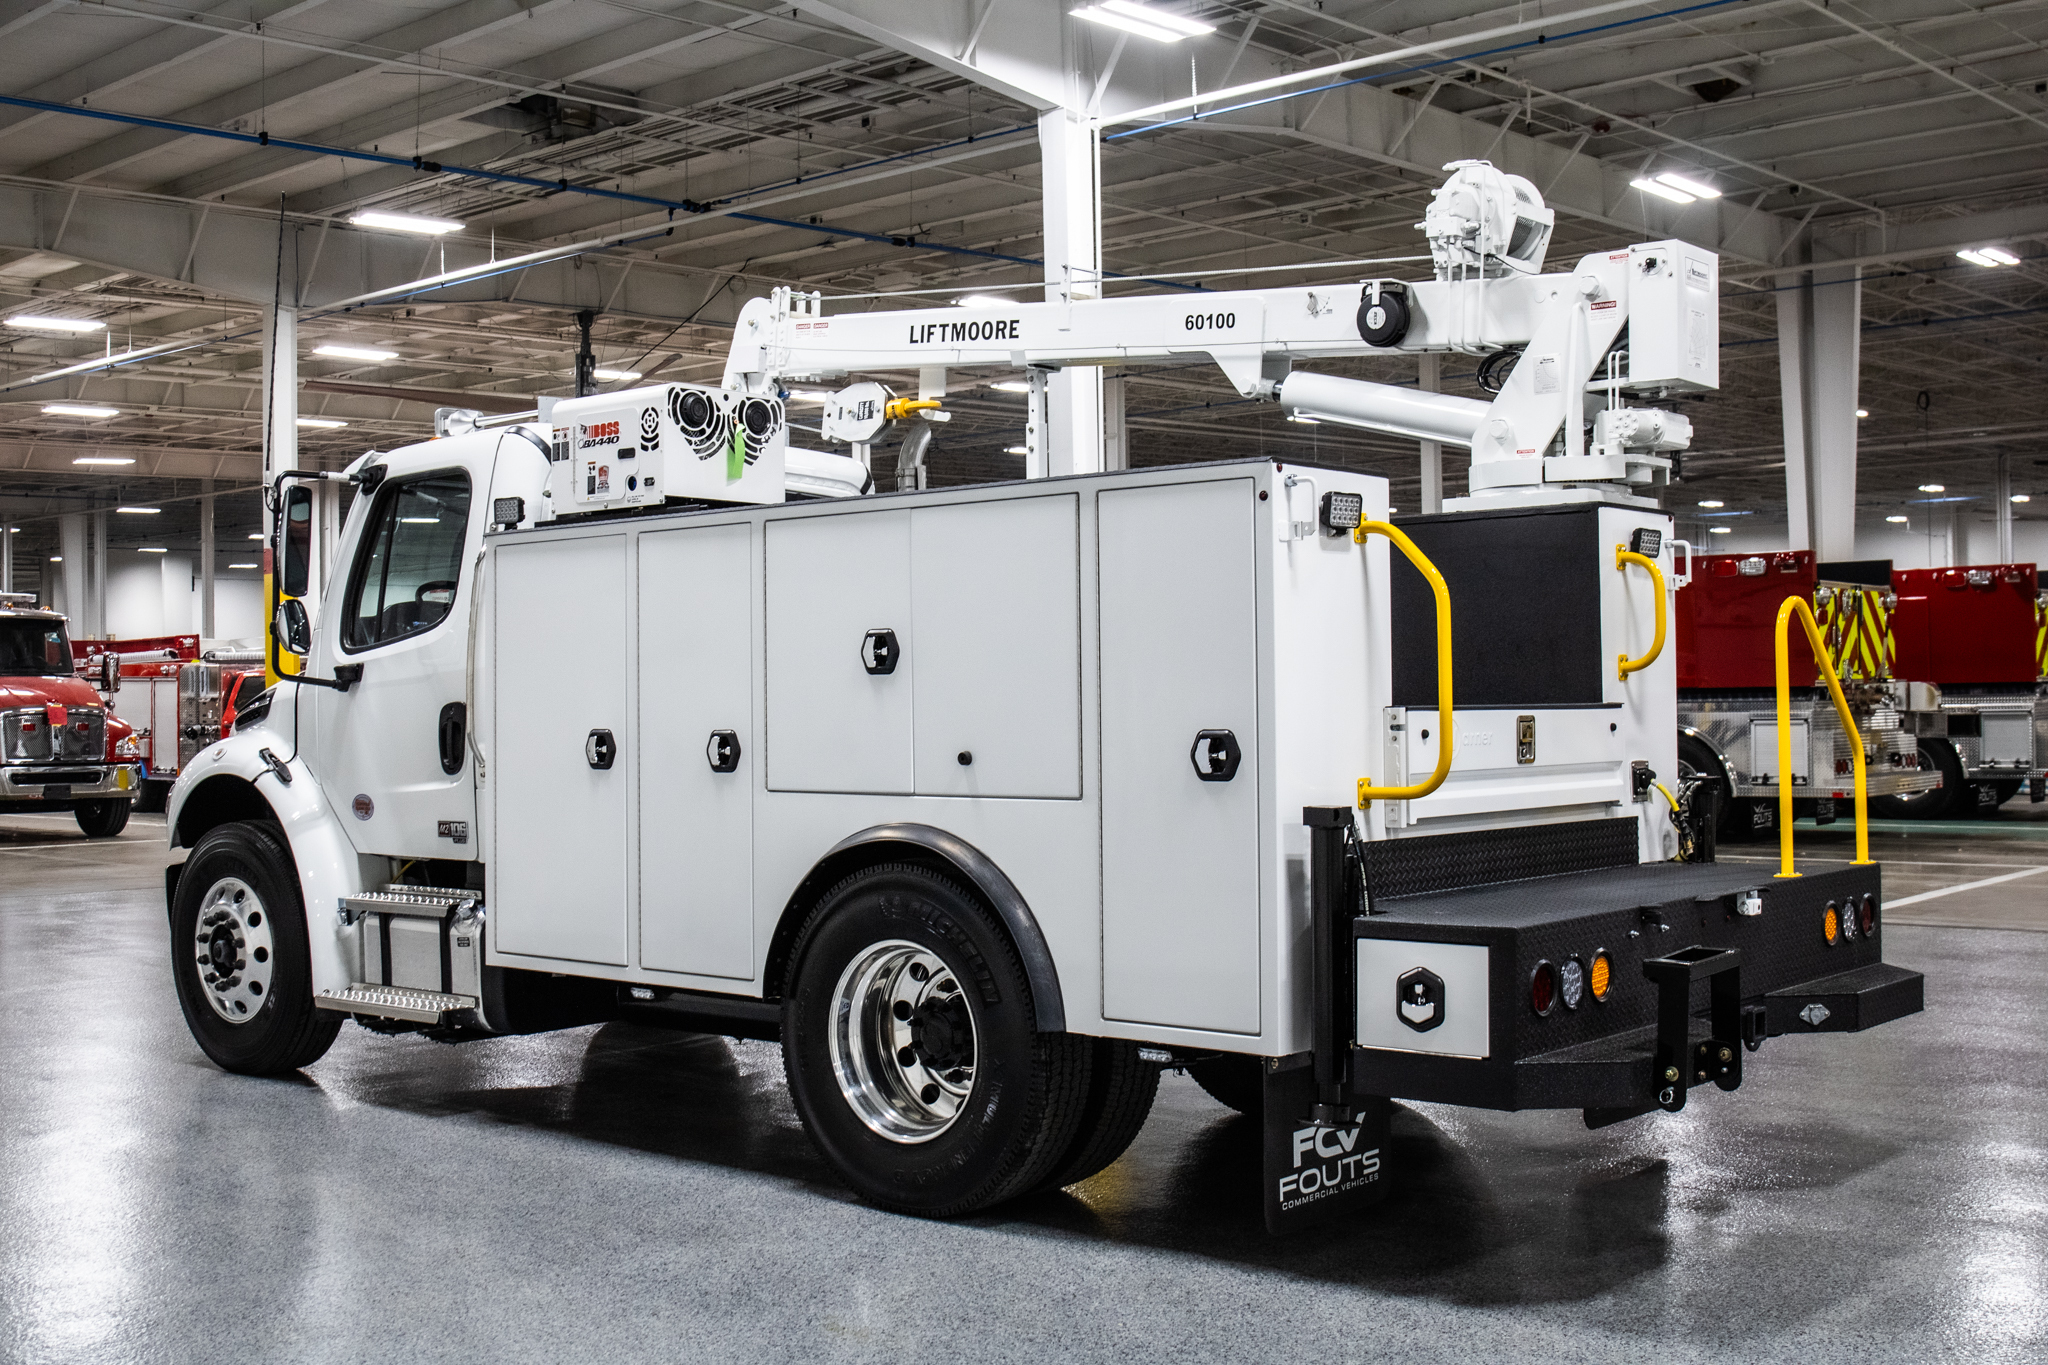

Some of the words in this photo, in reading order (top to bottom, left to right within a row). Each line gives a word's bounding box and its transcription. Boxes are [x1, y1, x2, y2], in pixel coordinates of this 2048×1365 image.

[1591, 301, 1616, 310] WARNING!
[909, 319, 1020, 344] LIFTMOORE
[1185, 312, 1236, 331] 60100
[593, 421, 620, 438] BOSS
[582, 435, 620, 449] BA440
[439, 823, 450, 835] M2
[450, 822, 467, 837] 106
[906, 900, 1002, 1006] MICHELIN
[1293, 1111, 1366, 1169] FCV
[1280, 1148, 1380, 1202] FOUTS
[1281, 1186, 1339, 1211] COMMERCIAL
[1340, 1172, 1379, 1191] VEHICLES
